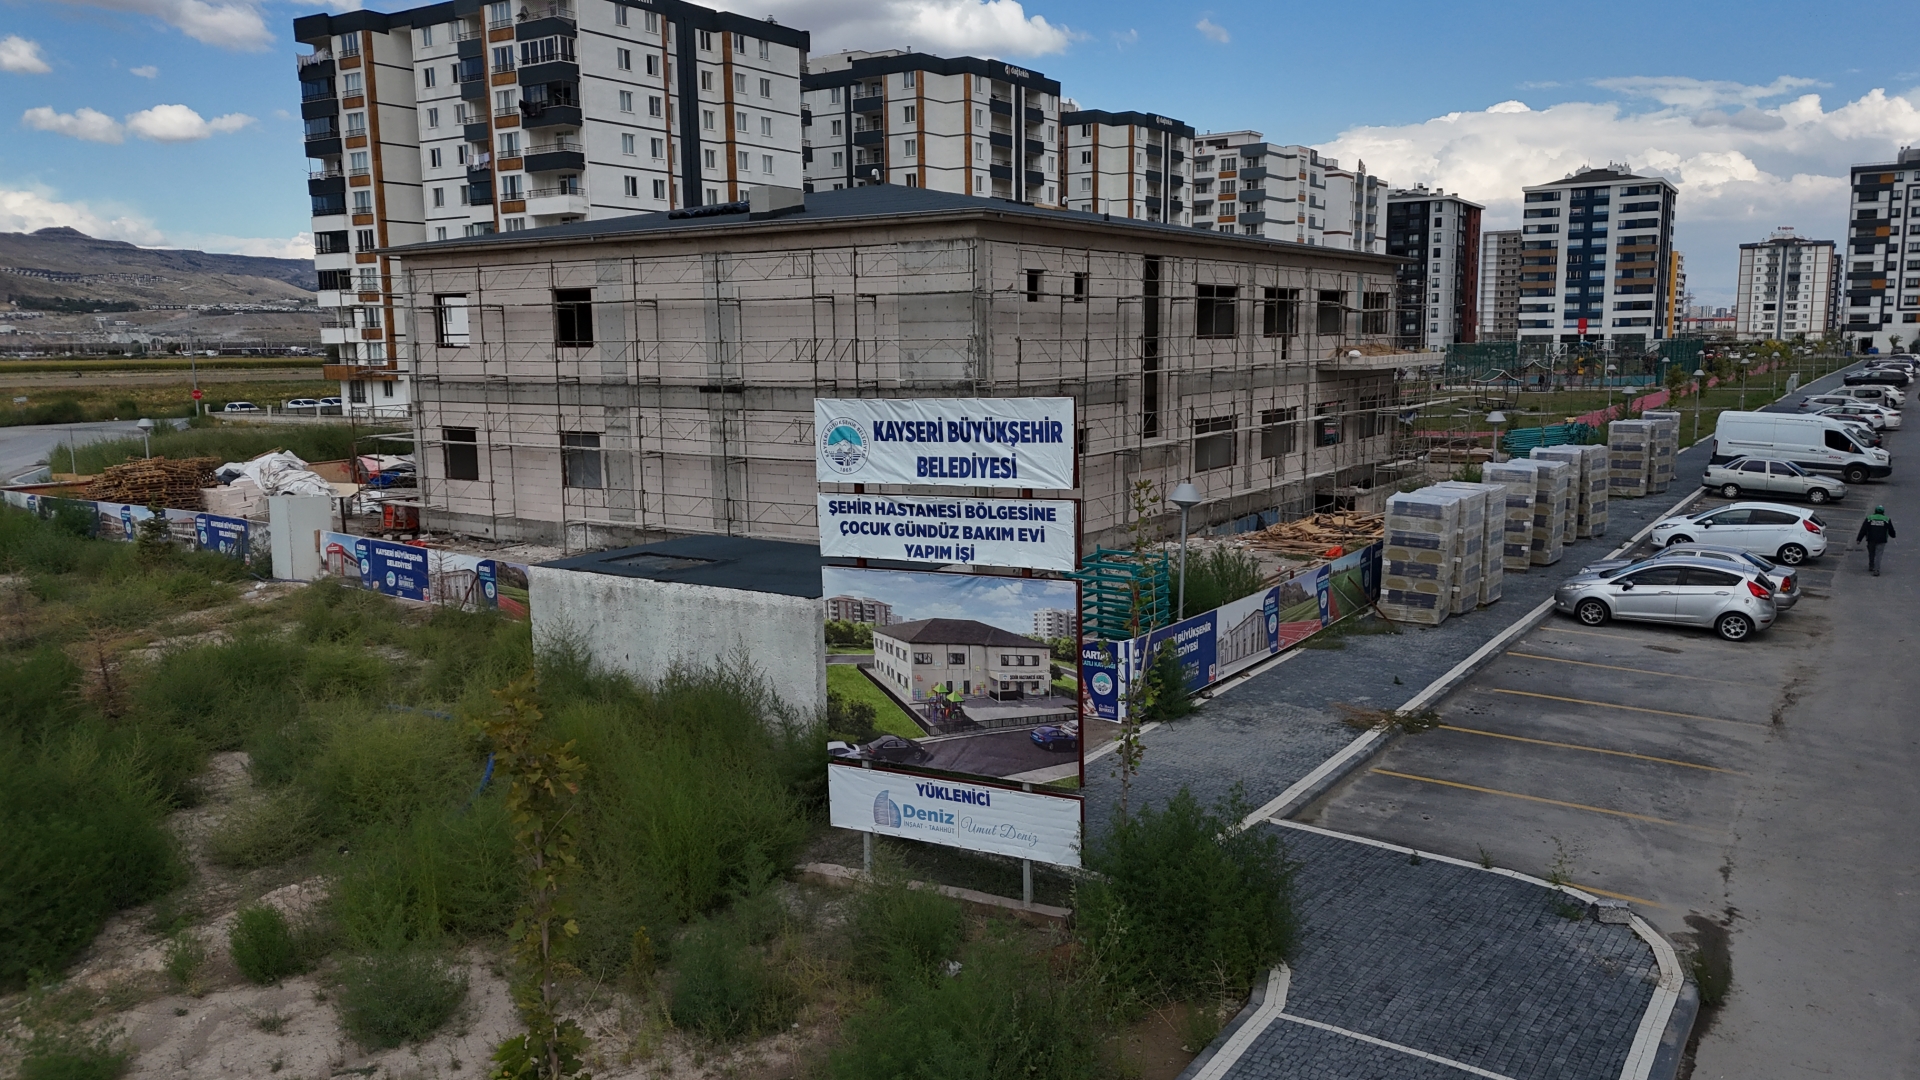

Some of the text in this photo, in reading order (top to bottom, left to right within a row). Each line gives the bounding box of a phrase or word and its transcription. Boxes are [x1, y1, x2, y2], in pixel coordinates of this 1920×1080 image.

[873, 416, 1062, 446] KAYSERİ BÜYÜKŞEHİR
[916, 452, 1018, 479] BELEDİYESİ
[828, 500, 1056, 522] ŞEHİR HASTANESİ BÖLGESİNE
[840, 520, 1045, 542] ÇOCUK GÜNDÜZ BAKIM EVİ
[904, 542, 975, 563] YAPIM İŞİ
[1178, 621, 1212, 643] BÜYÜKŞEHİR
[916, 782, 991, 806] YÜKLENİCİ
[903, 804, 954, 825] Deniz
[904, 820, 923, 829] İNŞAAT
[929, 825, 954, 834] TAAHHÜT
[960, 815, 1040, 848] Umut Deniz
